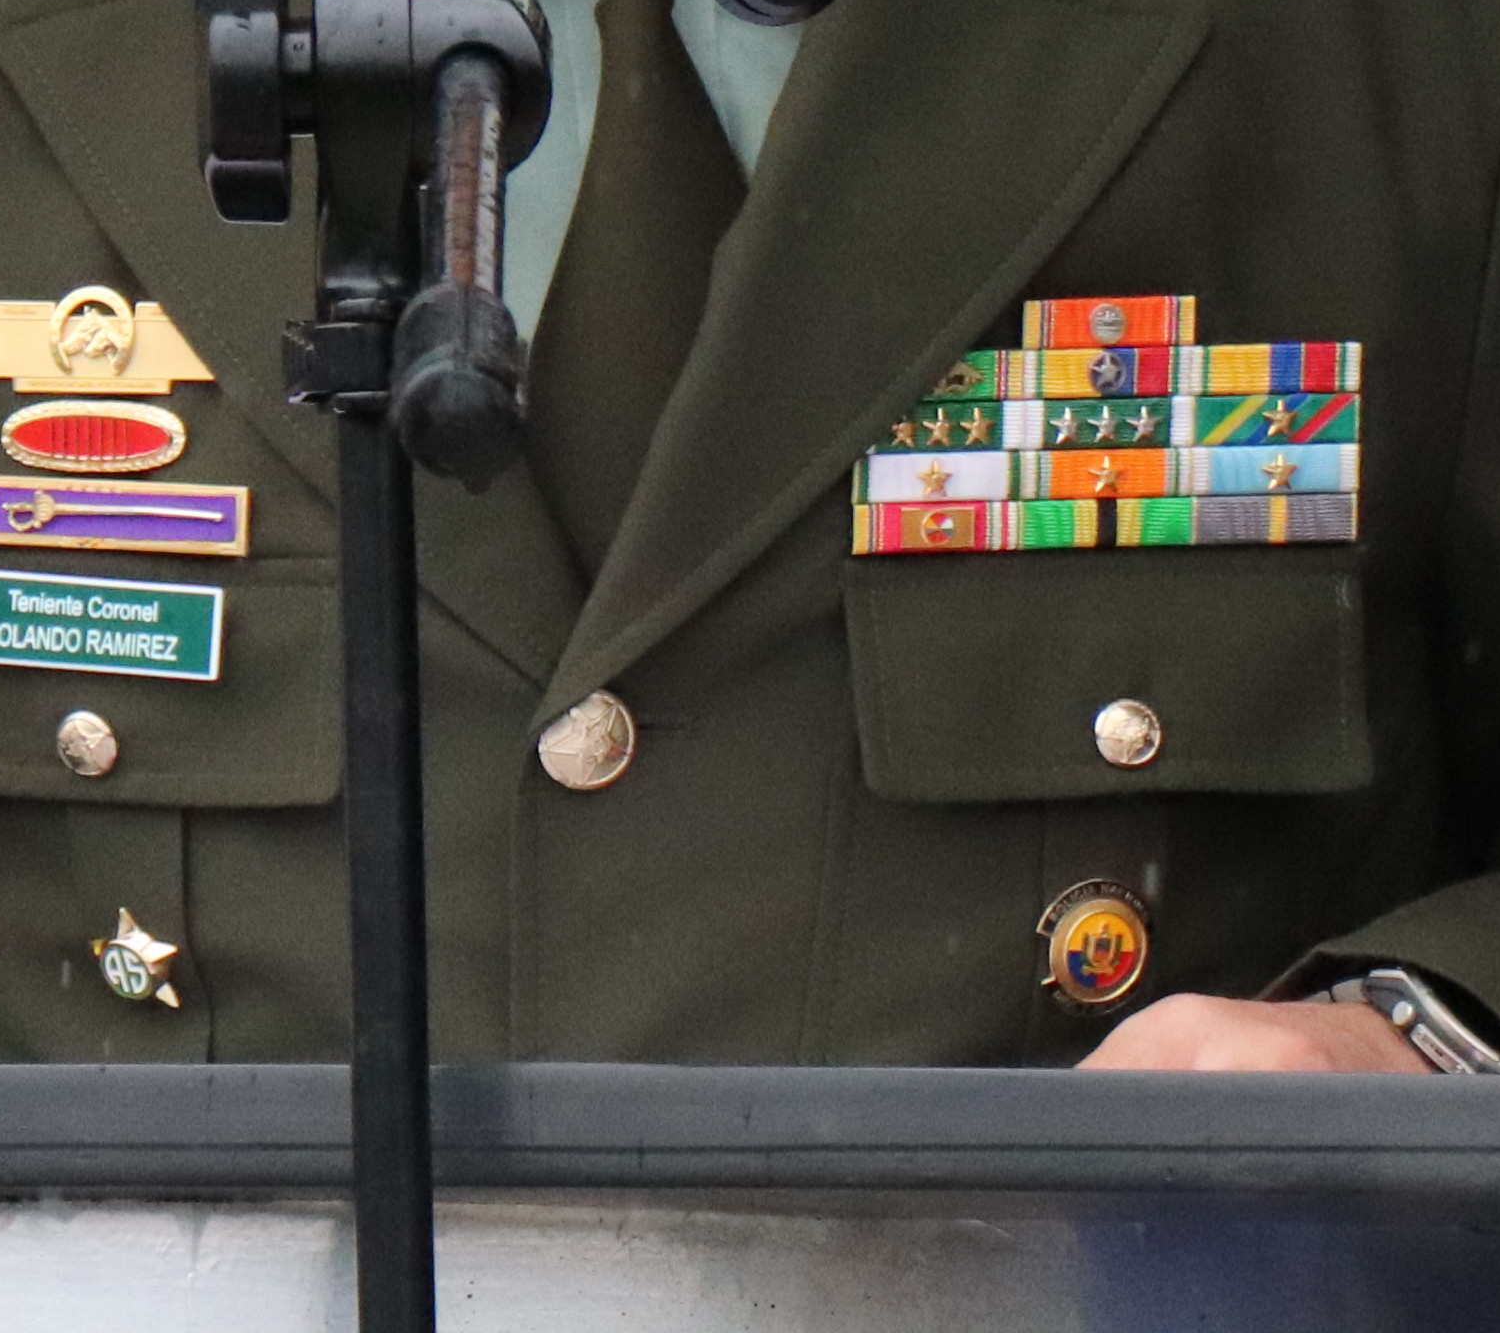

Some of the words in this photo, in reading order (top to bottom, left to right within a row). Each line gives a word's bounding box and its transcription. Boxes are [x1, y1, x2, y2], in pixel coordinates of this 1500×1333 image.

[8, 589, 84, 617] Teniente
[87, 595, 160, 623] Coronel
[85, 629, 179, 662] RAMIREZ
[105, 949, 148, 994] AS
